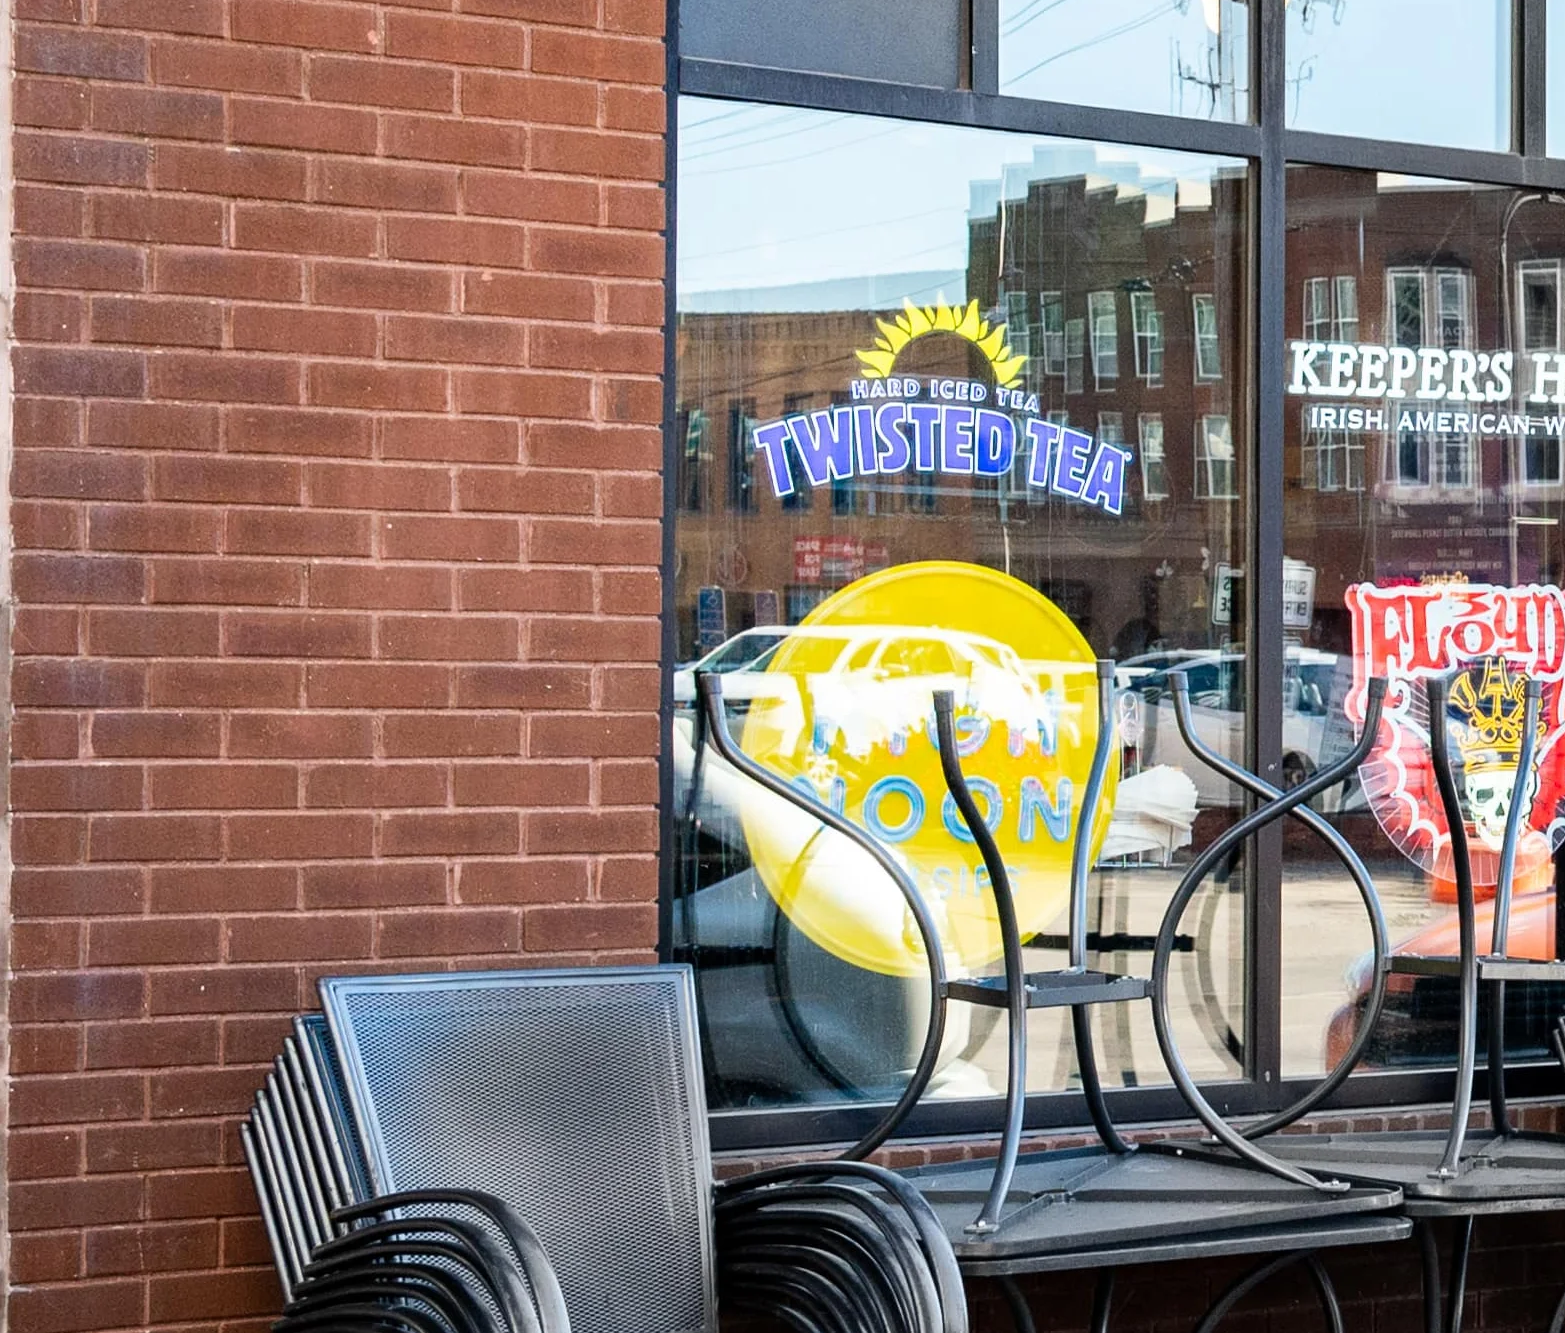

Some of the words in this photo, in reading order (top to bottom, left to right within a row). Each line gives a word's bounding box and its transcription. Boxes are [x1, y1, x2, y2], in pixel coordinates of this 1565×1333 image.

[851, 378, 920, 401] HARD
[930, 381, 987, 403] ICED
[996, 386, 1040, 414] TEA
[1288, 341, 1513, 403] KEEPER'S
[753, 402, 1016, 498] TWISTED
[1026, 417, 1132, 516] TEA
